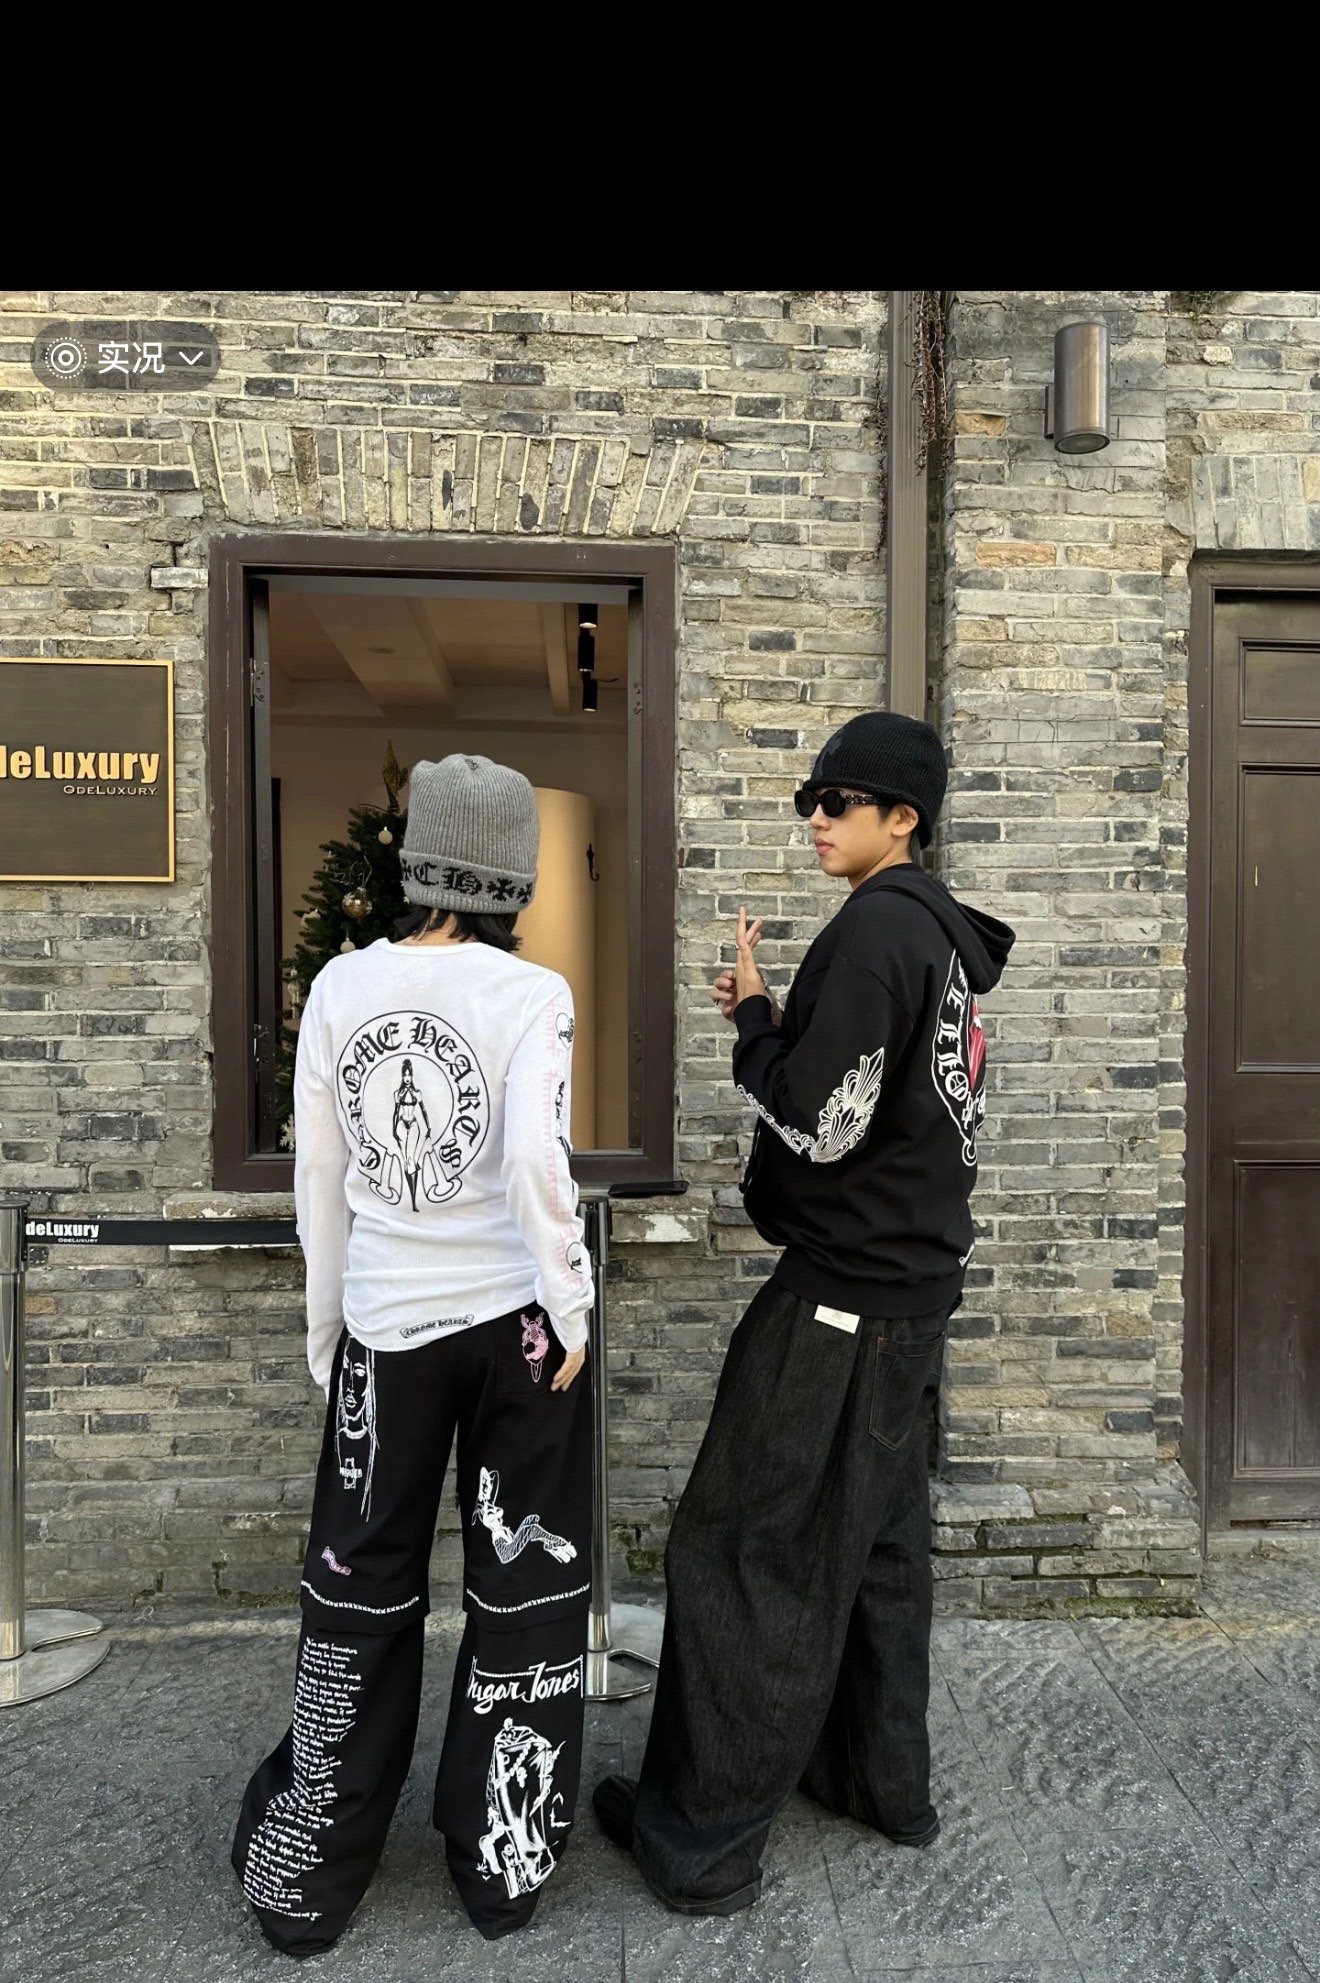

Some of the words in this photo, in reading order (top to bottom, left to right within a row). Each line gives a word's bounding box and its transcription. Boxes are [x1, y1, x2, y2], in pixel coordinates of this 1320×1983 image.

[407, 1015, 482, 1169] HEARTS
[25, 1221, 99, 1238] deLuxury
[521, 1661, 580, 1703] Jones
